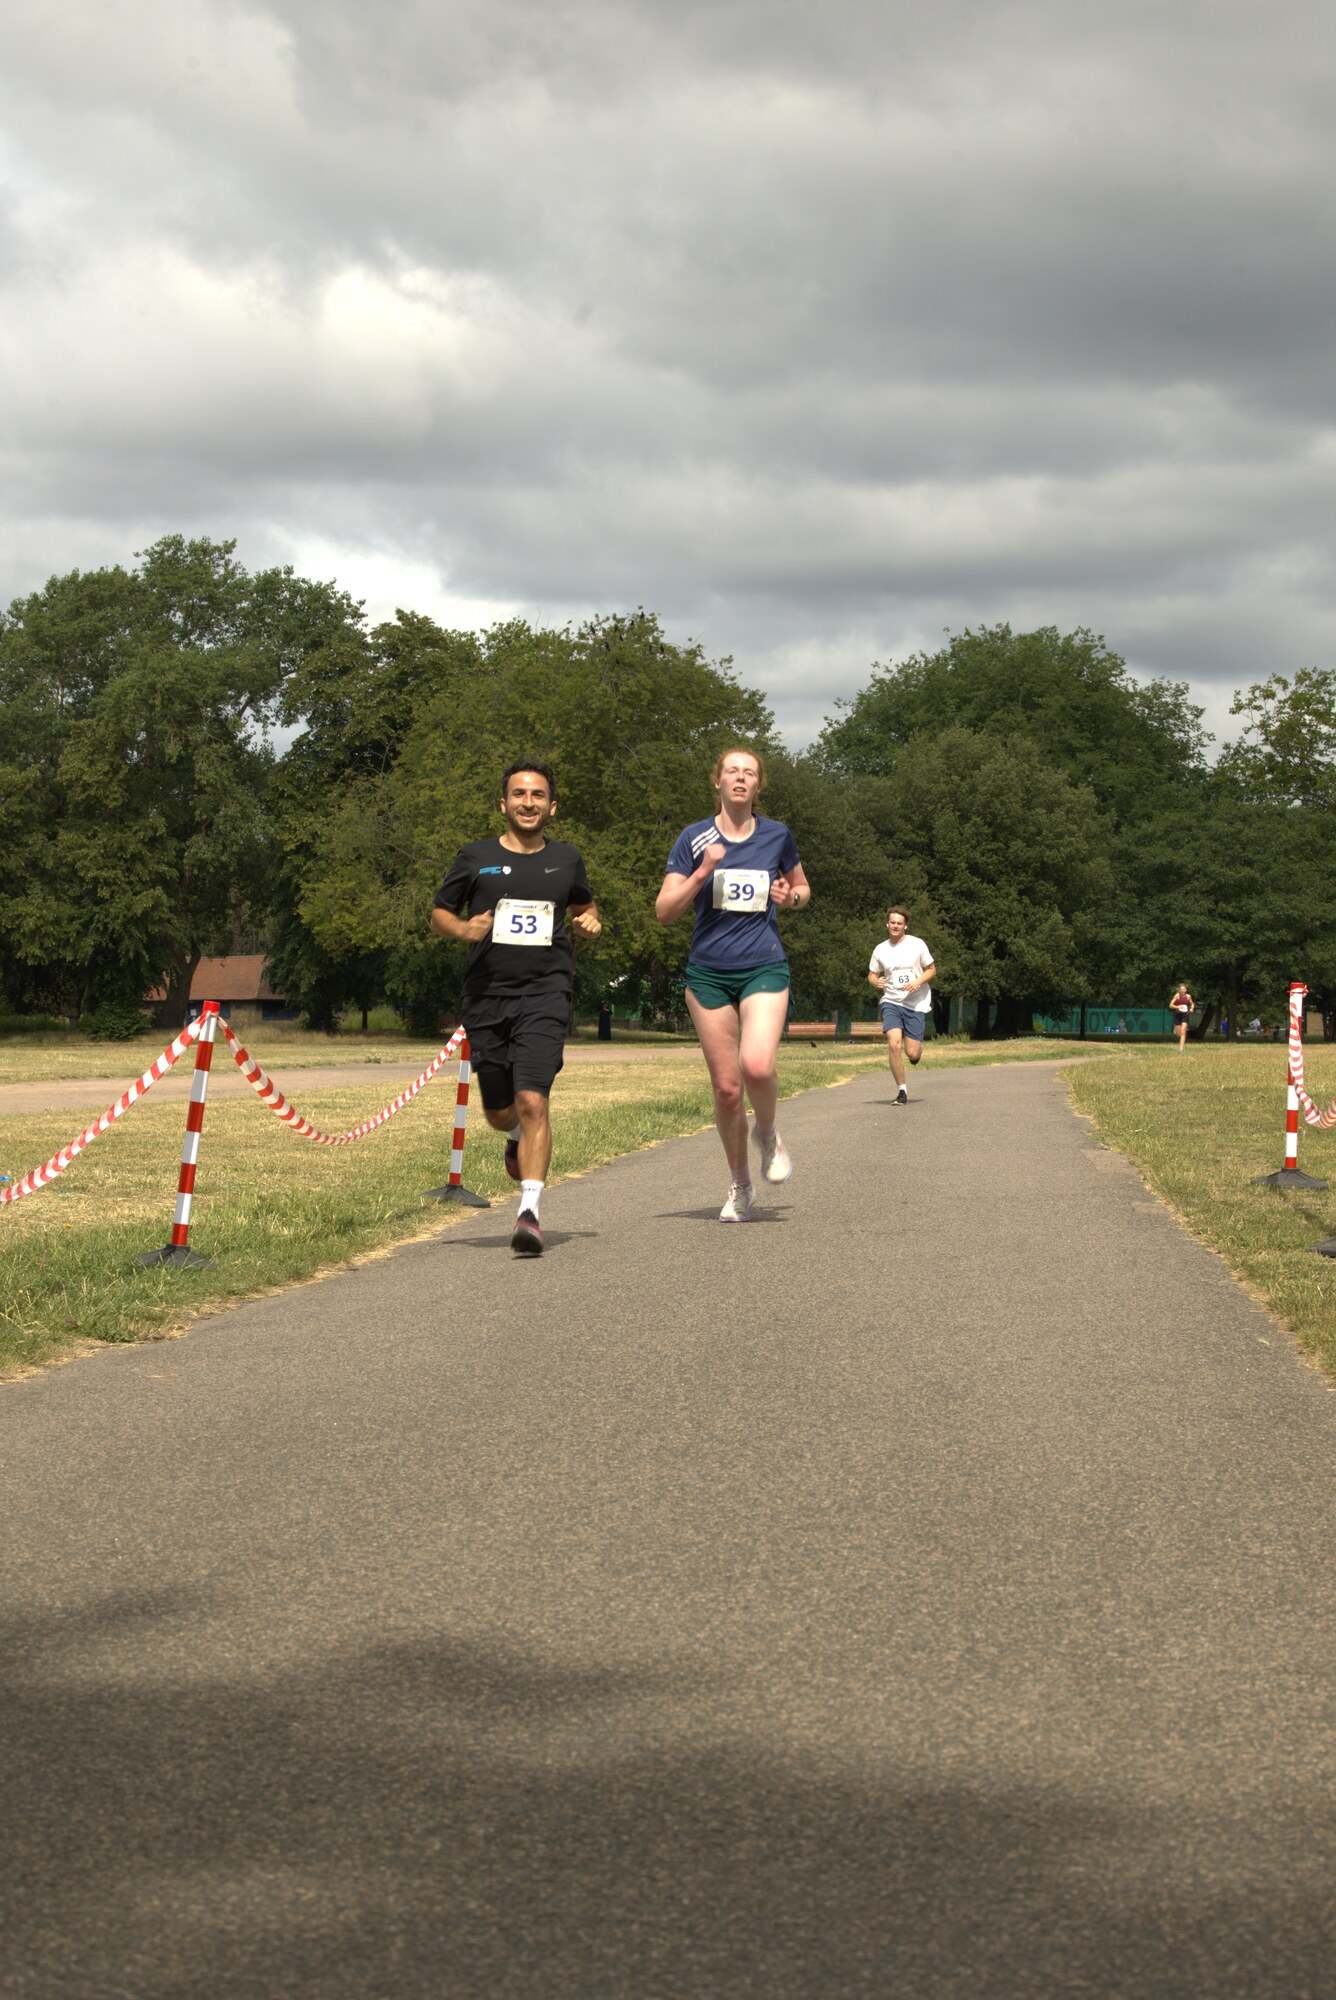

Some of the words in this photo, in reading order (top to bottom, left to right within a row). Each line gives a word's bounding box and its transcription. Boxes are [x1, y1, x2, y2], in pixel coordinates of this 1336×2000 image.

[728, 883, 755, 901] 39
[510, 914, 537, 934] 53
[898, 975, 910, 984] 63
